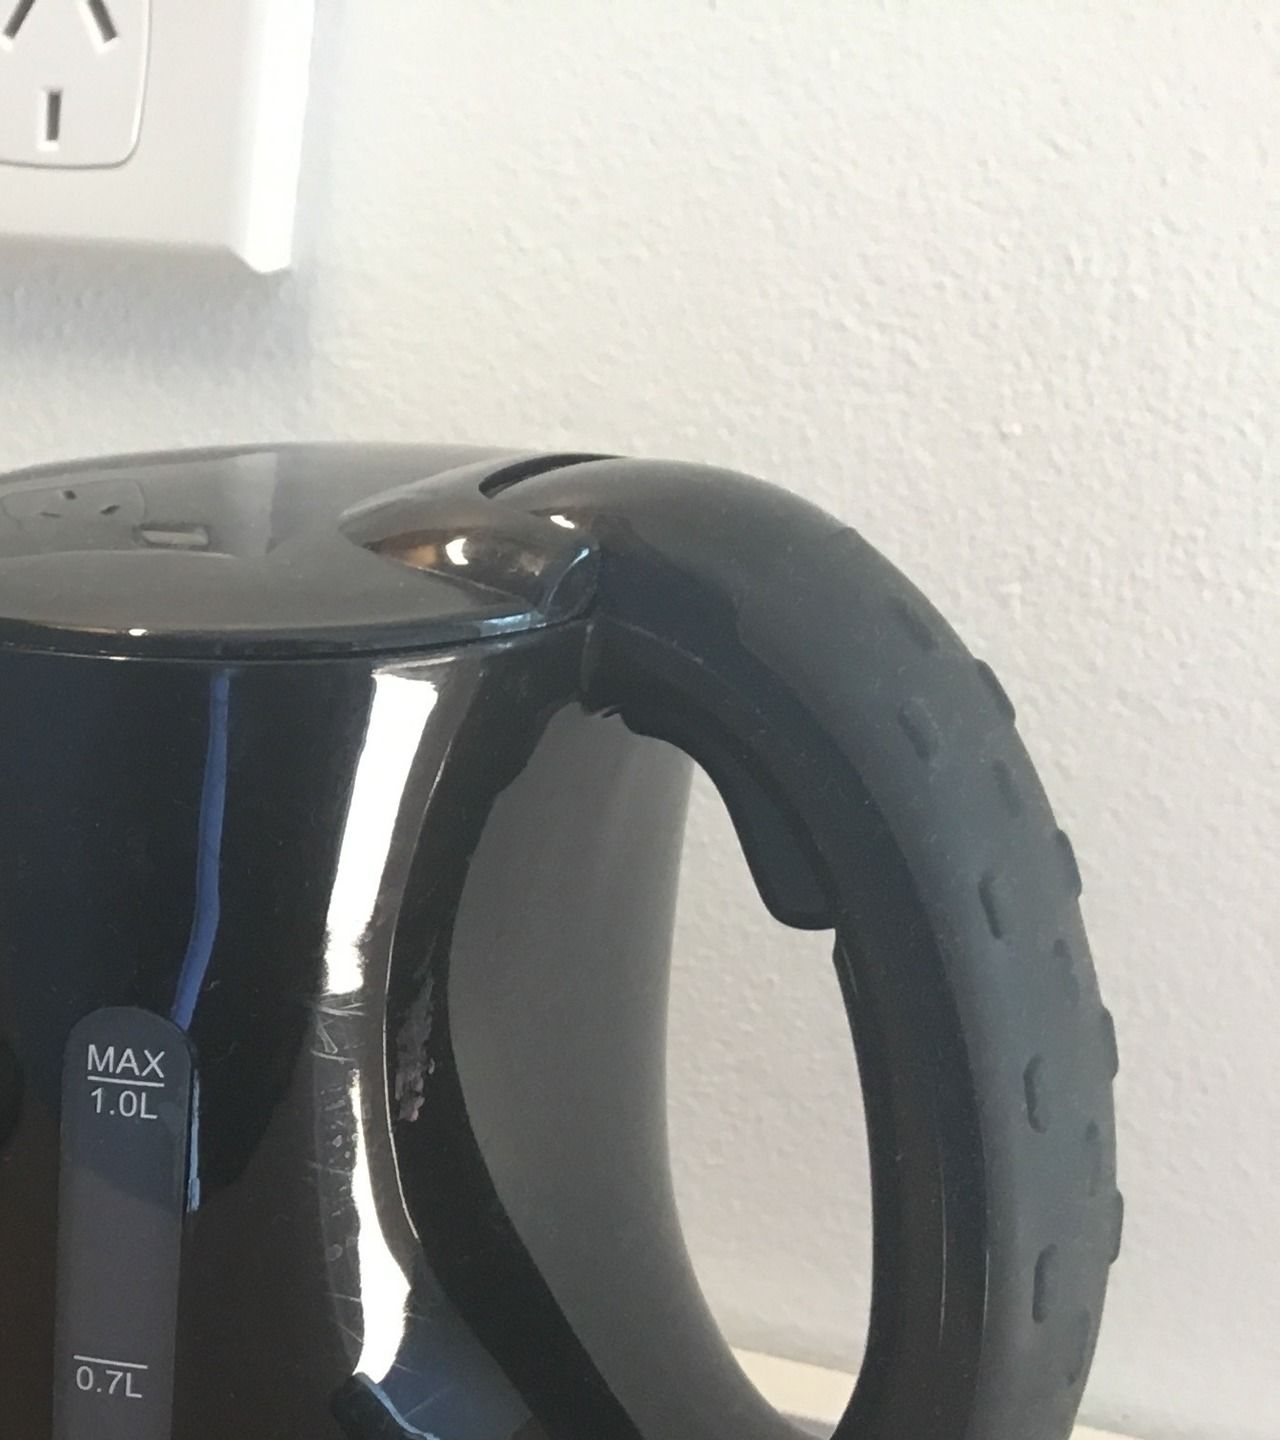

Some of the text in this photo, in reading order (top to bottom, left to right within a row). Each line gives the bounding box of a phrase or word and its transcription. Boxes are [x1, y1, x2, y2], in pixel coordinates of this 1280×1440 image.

[87, 1043, 165, 1079] MAX
[90, 1087, 158, 1120] 1.0L
[75, 1365, 143, 1399] 0.7L
